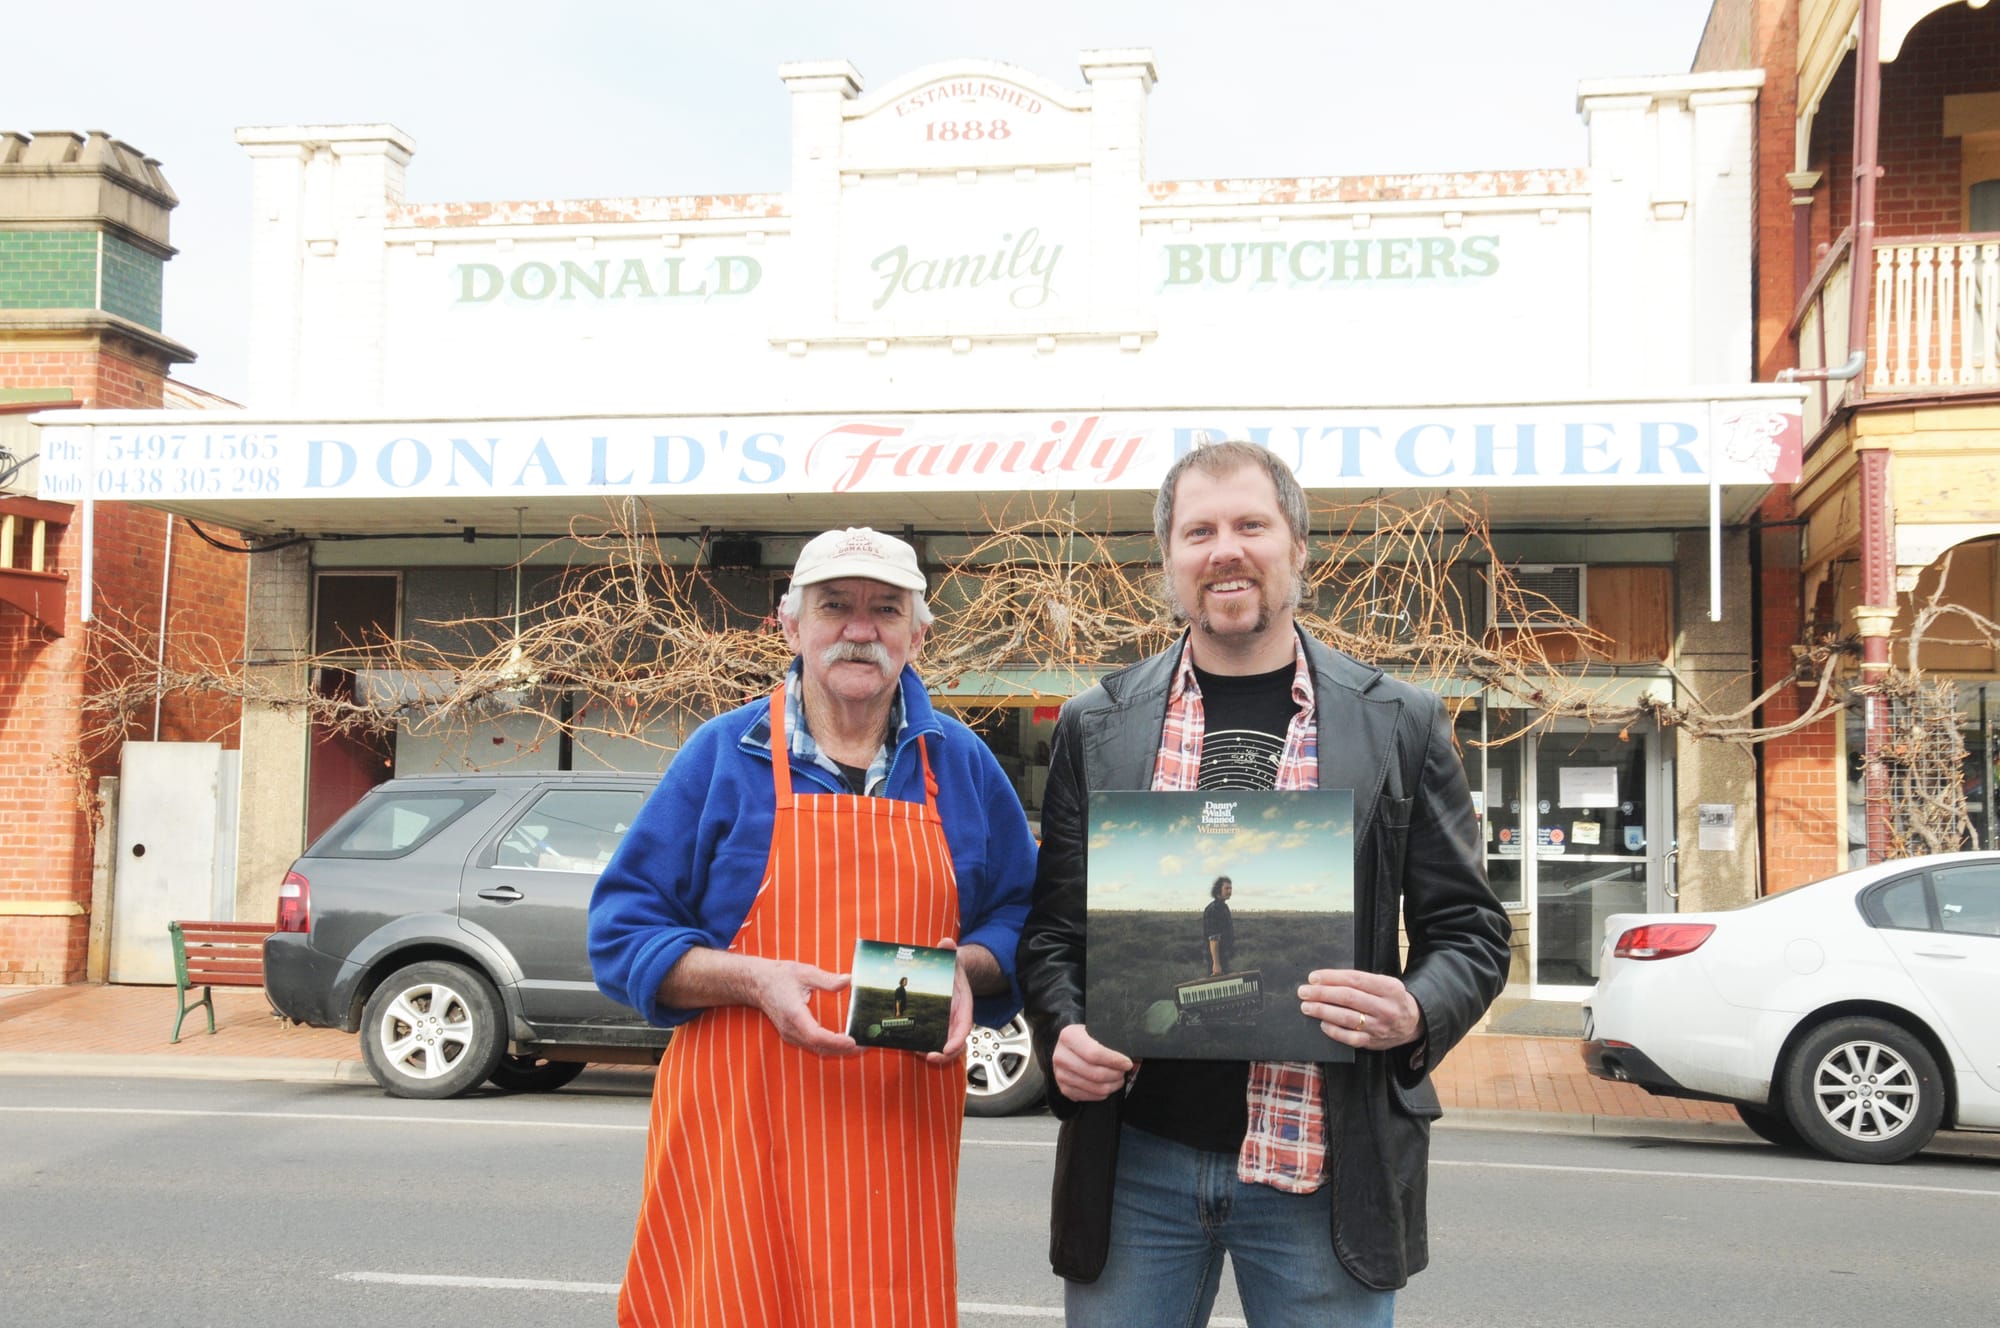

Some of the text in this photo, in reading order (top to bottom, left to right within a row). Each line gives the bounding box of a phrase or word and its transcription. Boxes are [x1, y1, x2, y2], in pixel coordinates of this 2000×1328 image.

[895, 82, 1042, 117] ESTABLISHED
[925, 119, 1012, 142] 1888
[455, 226, 1501, 311] DONALD Family BUTCHERS
[49, 433, 279, 461] Ph: 5497 1565
[303, 431, 787, 488] DONALD'S
[805, 416, 1145, 494] Family
[98, 467, 163, 494] 0438
[173, 468, 222, 494] 305
[231, 466, 281, 493] 298
